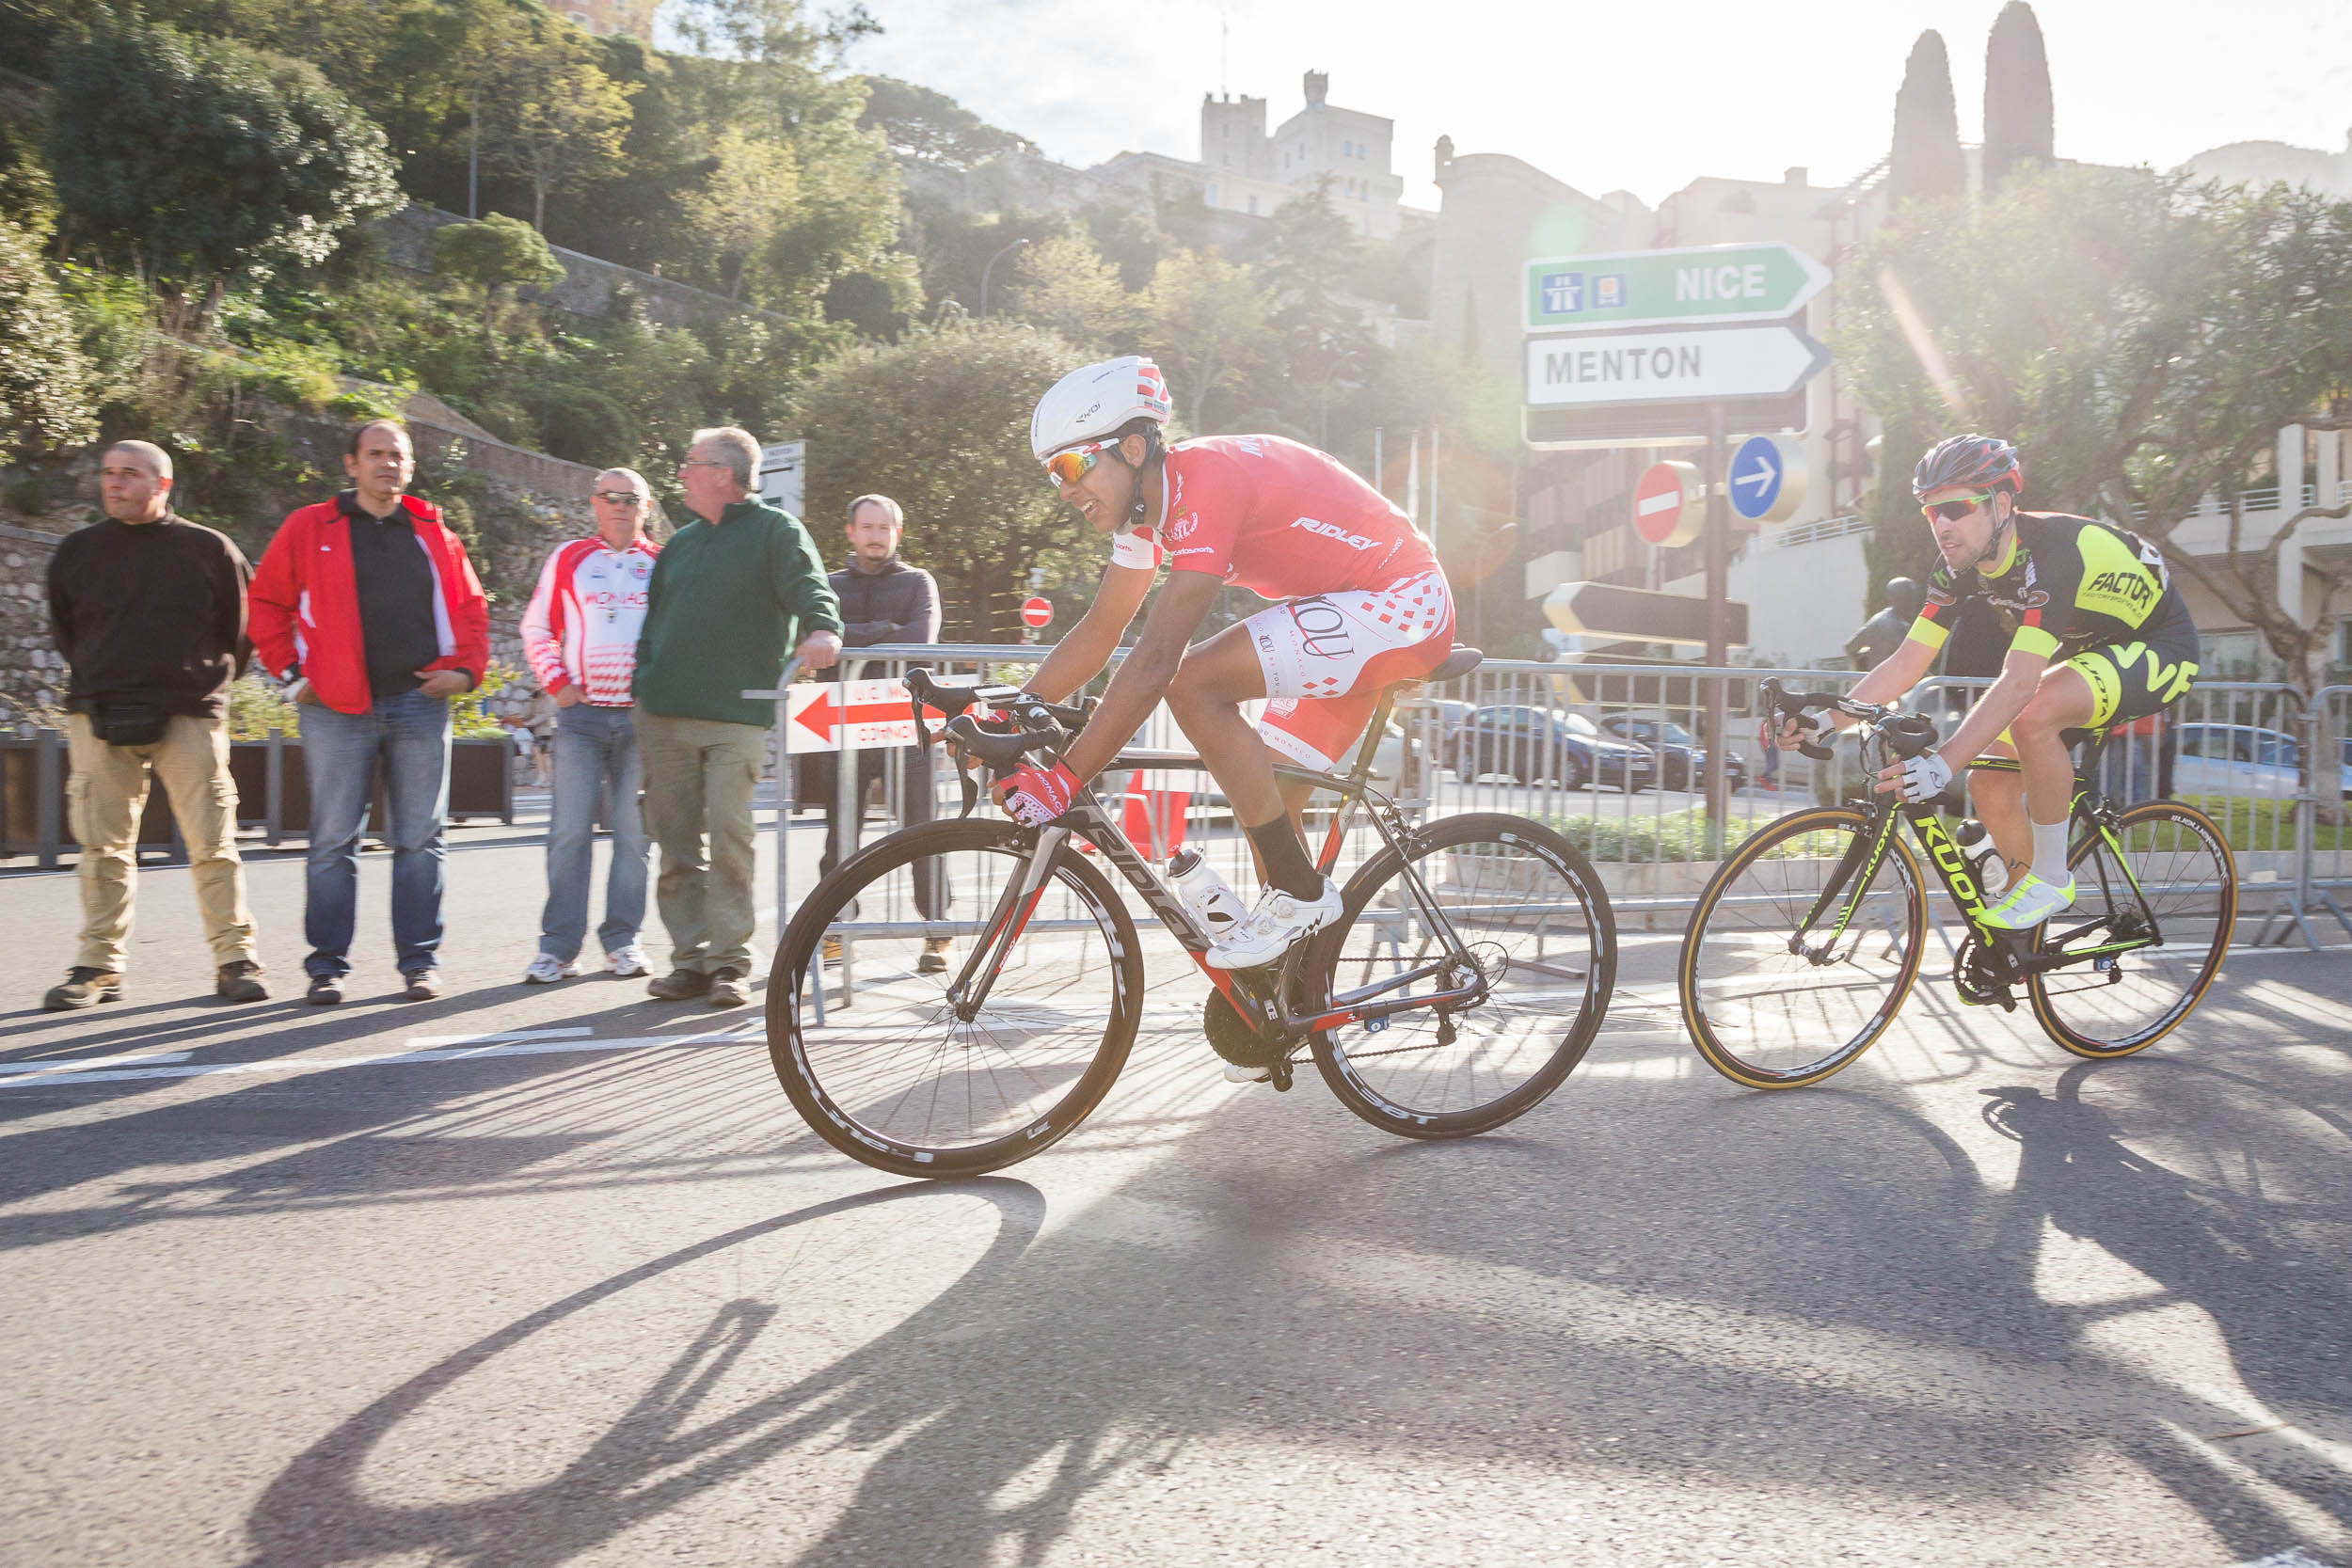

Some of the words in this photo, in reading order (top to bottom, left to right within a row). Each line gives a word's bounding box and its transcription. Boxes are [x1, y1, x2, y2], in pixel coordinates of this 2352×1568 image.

[1676, 262, 1767, 302] NICE
[1546, 344, 1702, 386] MENTON
[1289, 516, 1382, 551] RIDLEY
[585, 591, 648, 605] MONAC
[1035, 772, 1066, 816] MONACO
[1866, 818, 1895, 878] KUOTA
